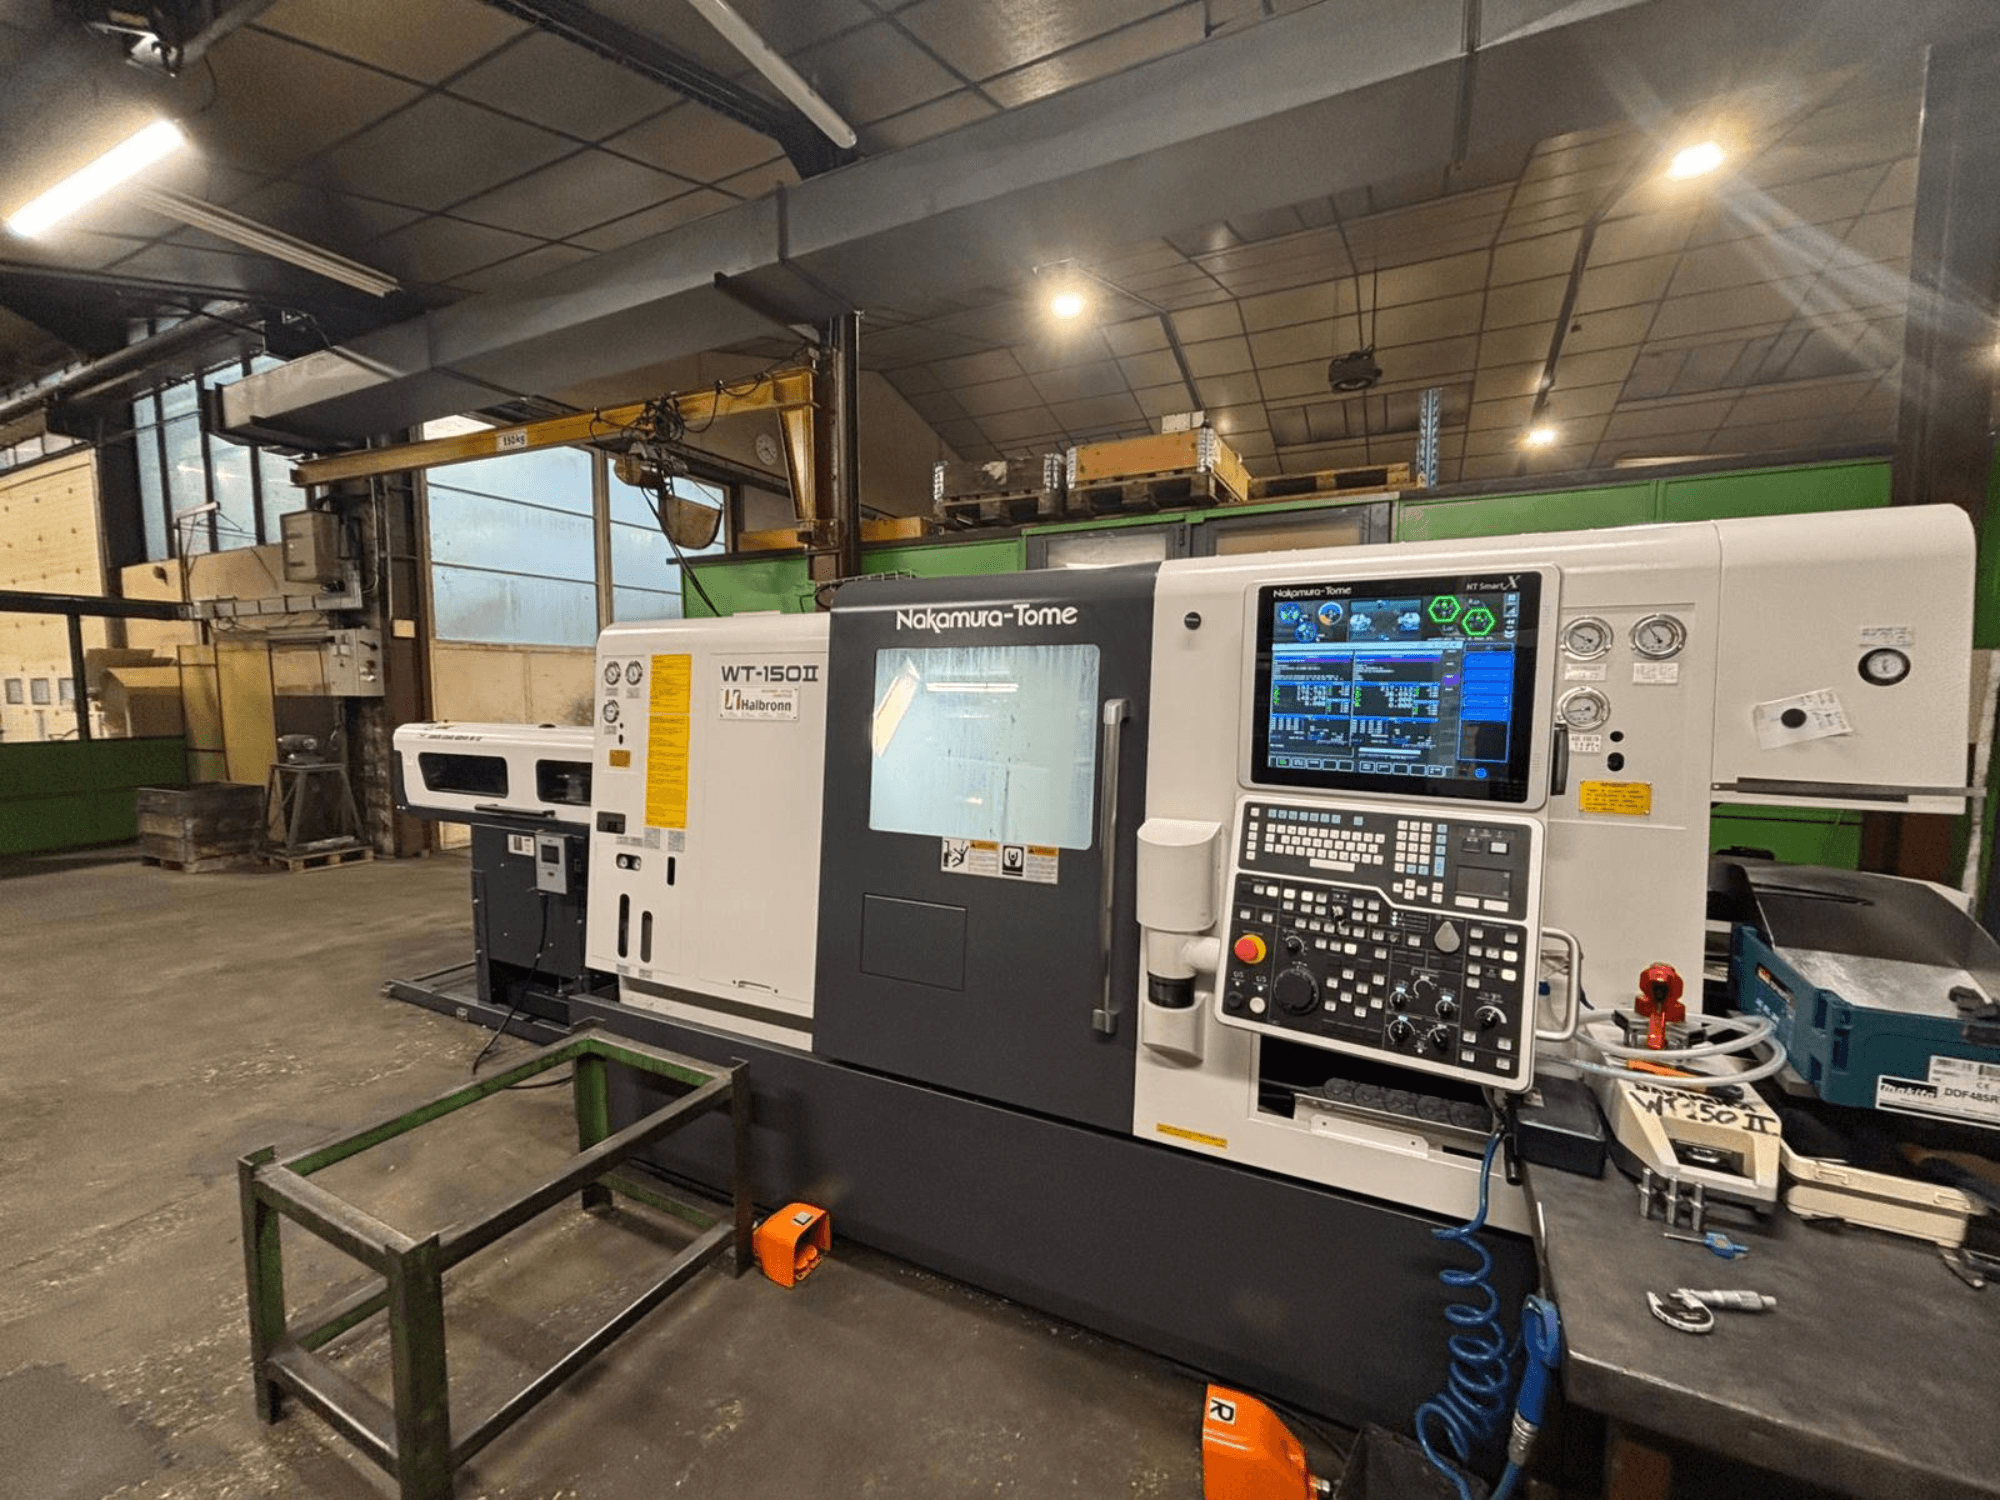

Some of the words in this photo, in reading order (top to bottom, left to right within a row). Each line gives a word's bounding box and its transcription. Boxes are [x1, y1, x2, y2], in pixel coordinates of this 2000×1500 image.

[1273, 586, 1352, 599] Nakamura-Tome
[895, 603, 1078, 634] Nakamura-Tome
[741, 699, 792, 711] Halbronn
[1210, 1399, 1235, 1422] R
